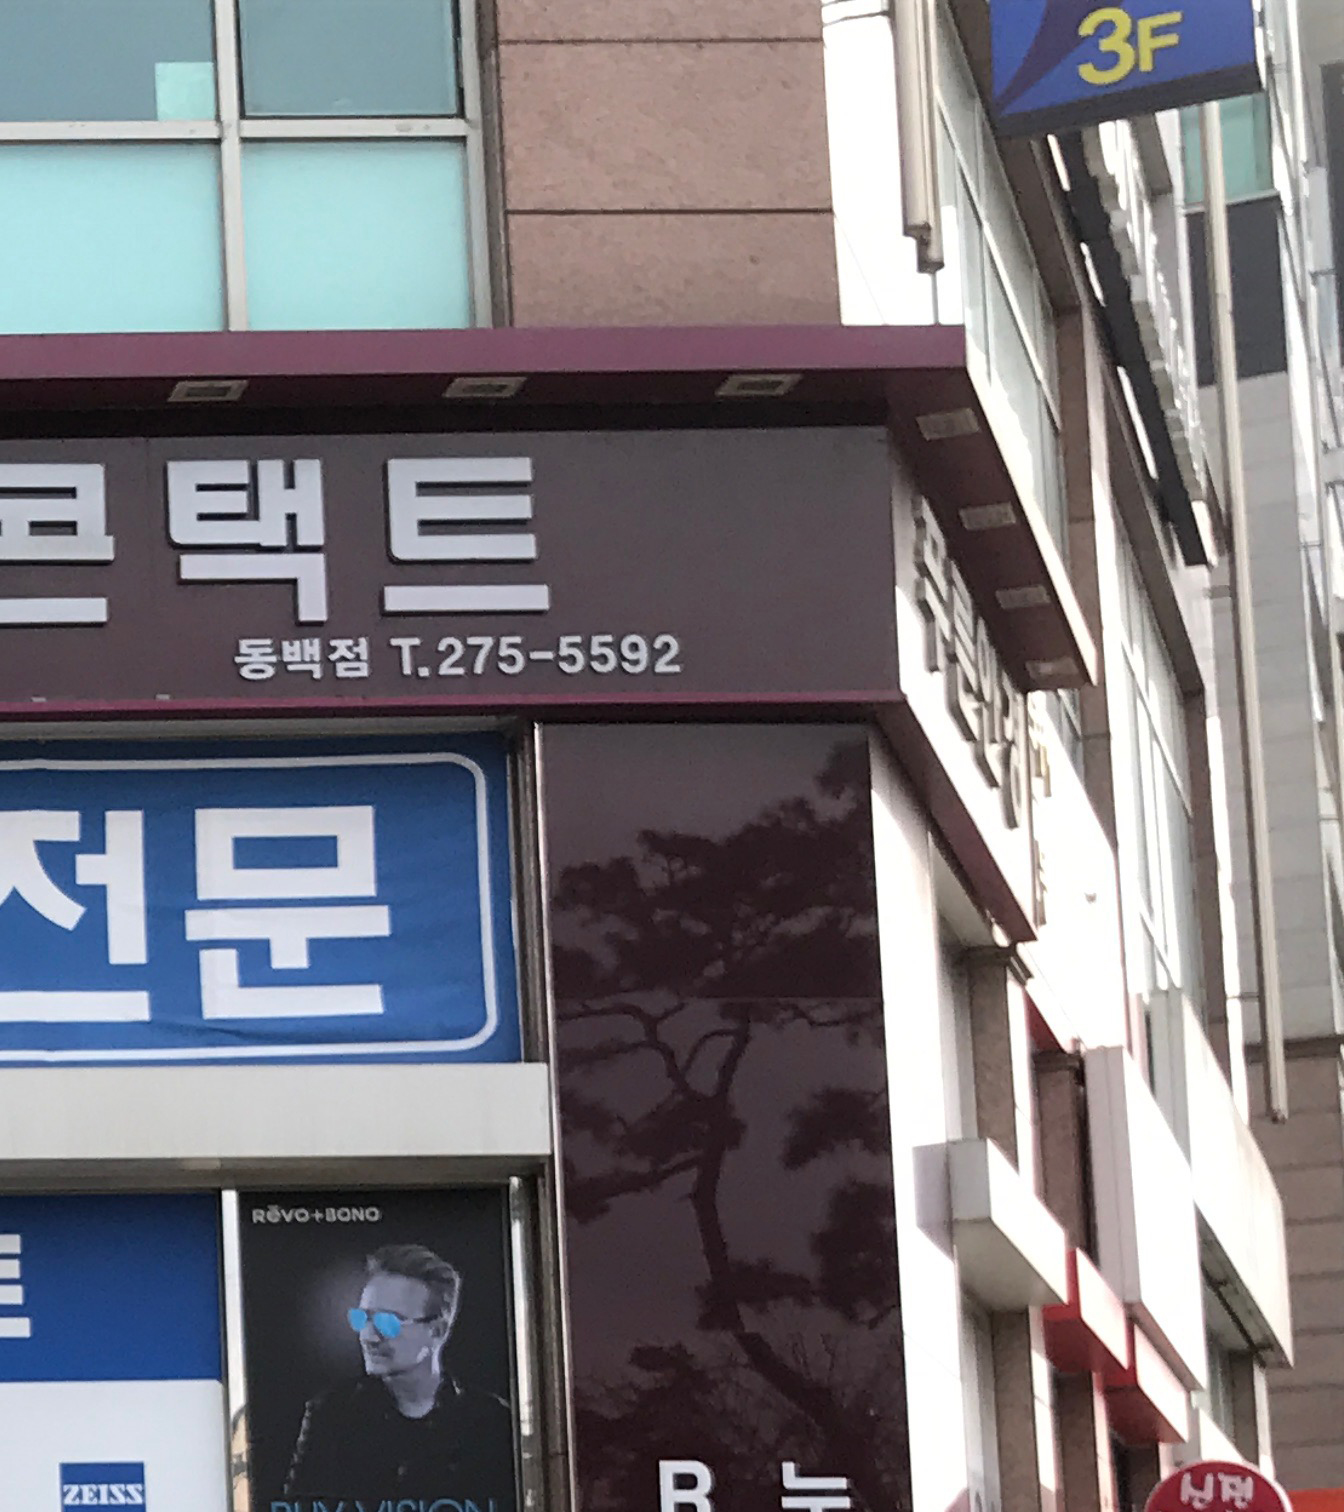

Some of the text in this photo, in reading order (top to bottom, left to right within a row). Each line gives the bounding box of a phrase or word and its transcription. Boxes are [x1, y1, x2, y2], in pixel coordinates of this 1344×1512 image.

[1078, 7, 1183, 85] 3F
[233, 634, 682, 681] 동백점 T.275-5592
[63, 1484, 143, 1506] ZEISS
